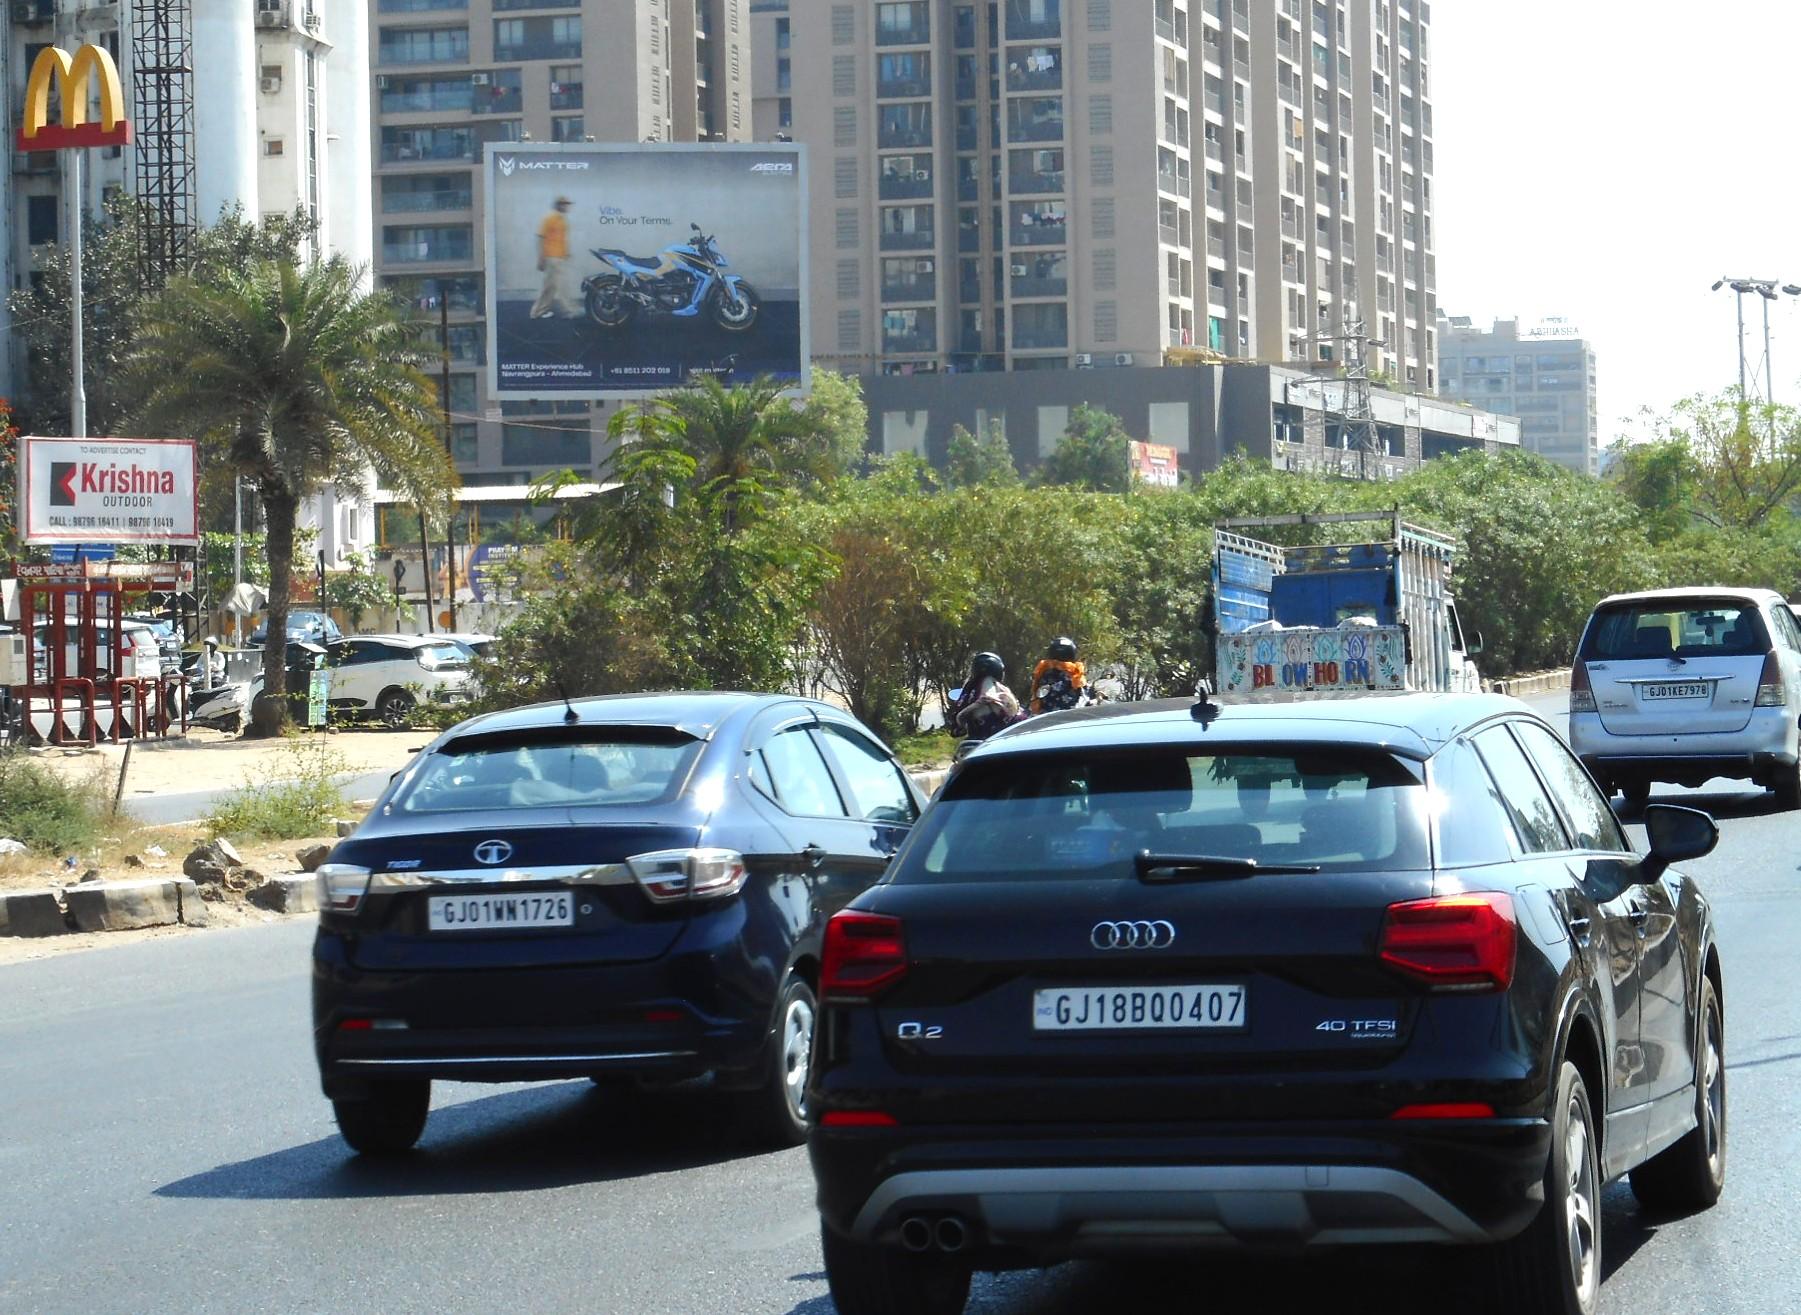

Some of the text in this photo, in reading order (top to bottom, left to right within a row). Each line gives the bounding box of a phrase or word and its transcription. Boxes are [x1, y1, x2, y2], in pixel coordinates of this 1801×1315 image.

[519, 162, 589, 170] MATTER
[600, 216, 614, 225] On
[616, 216, 637, 225] Your
[501, 363, 530, 371] MATTER
[119, 446, 146, 455] CONTACT
[81, 462, 174, 495] Krishna
[103, 496, 153, 507] OUTDOOR
[1056, 992, 1242, 1024] GJ18BQ0407
[1315, 1020, 1396, 1031] 40 TFSI
